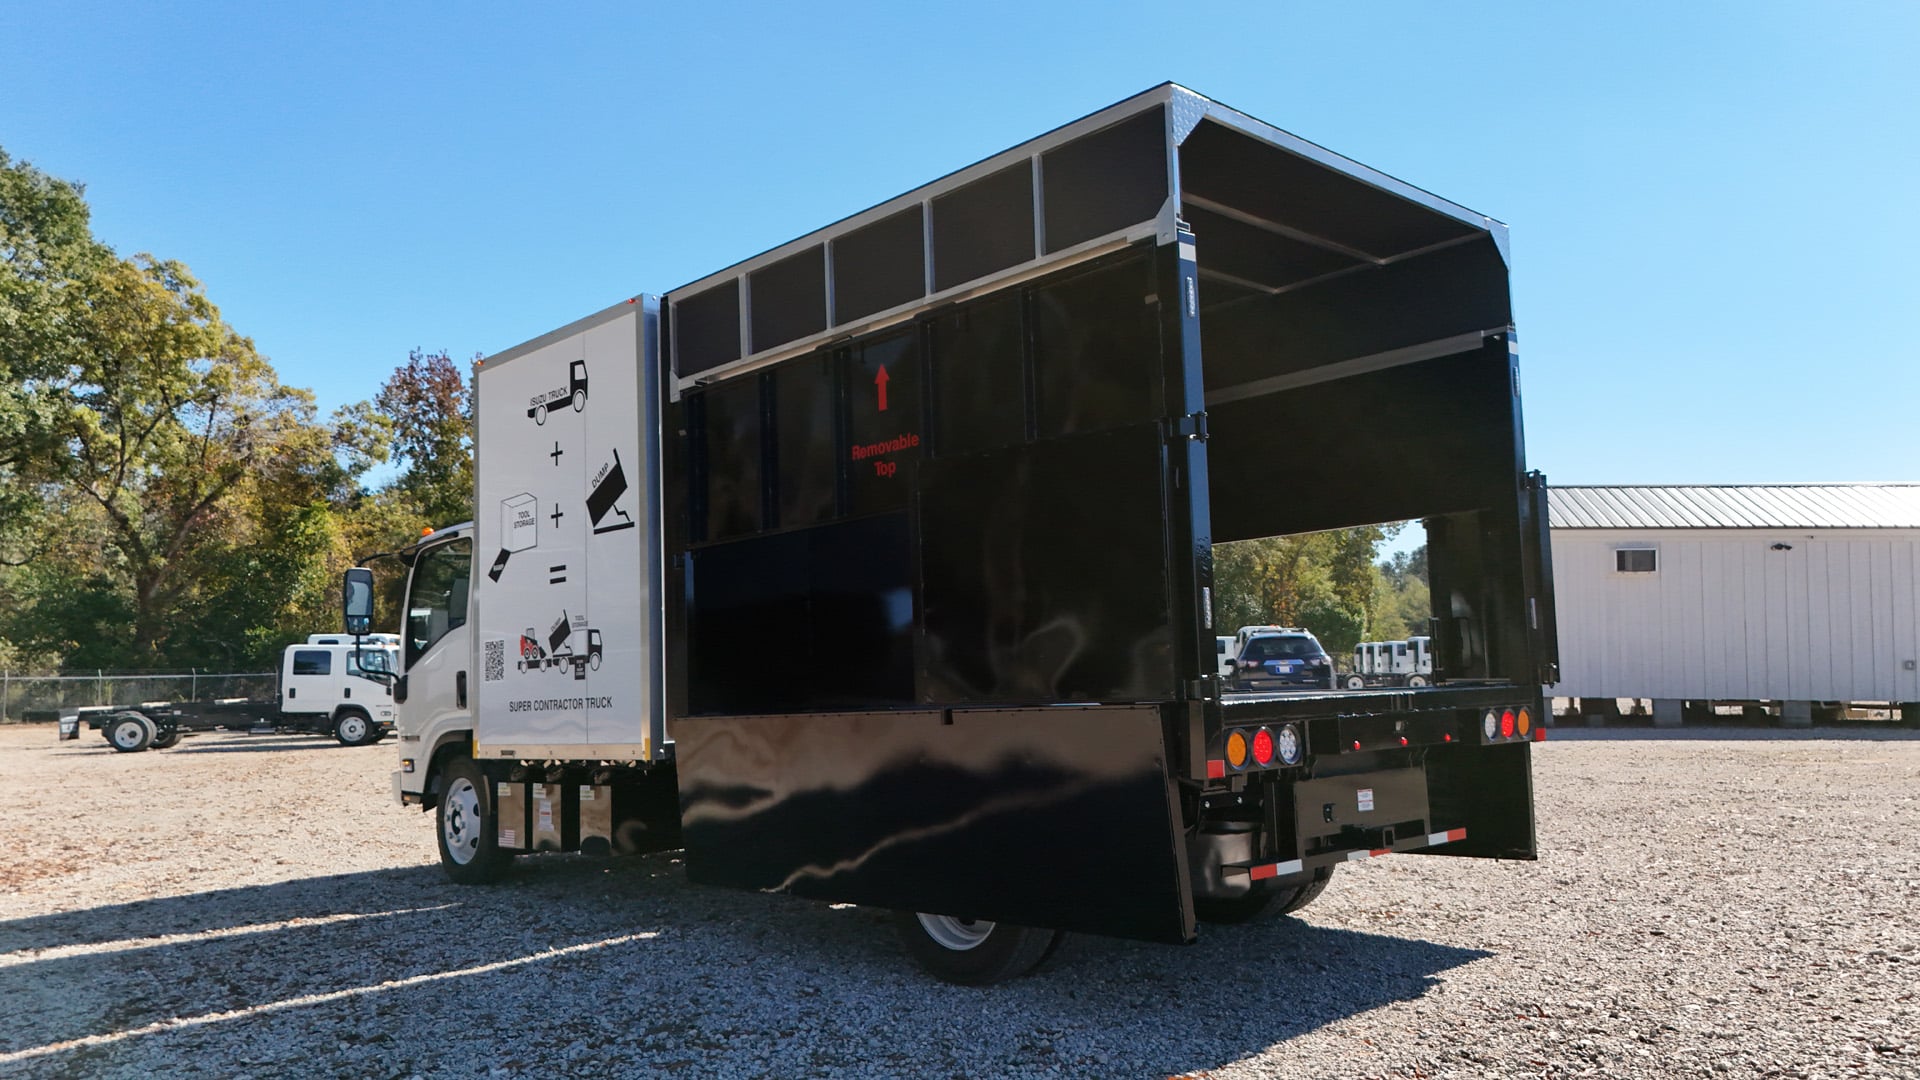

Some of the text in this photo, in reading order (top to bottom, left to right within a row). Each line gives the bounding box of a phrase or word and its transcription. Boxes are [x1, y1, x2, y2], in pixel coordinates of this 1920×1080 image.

[530, 386, 567, 406] ISUZU TRUCK
[852, 433, 919, 460] Removable
[592, 462, 608, 488] DUMP
[874, 461, 896, 478] Top
[509, 696, 613, 713] SUPER CONTRACTOR TRUCK
